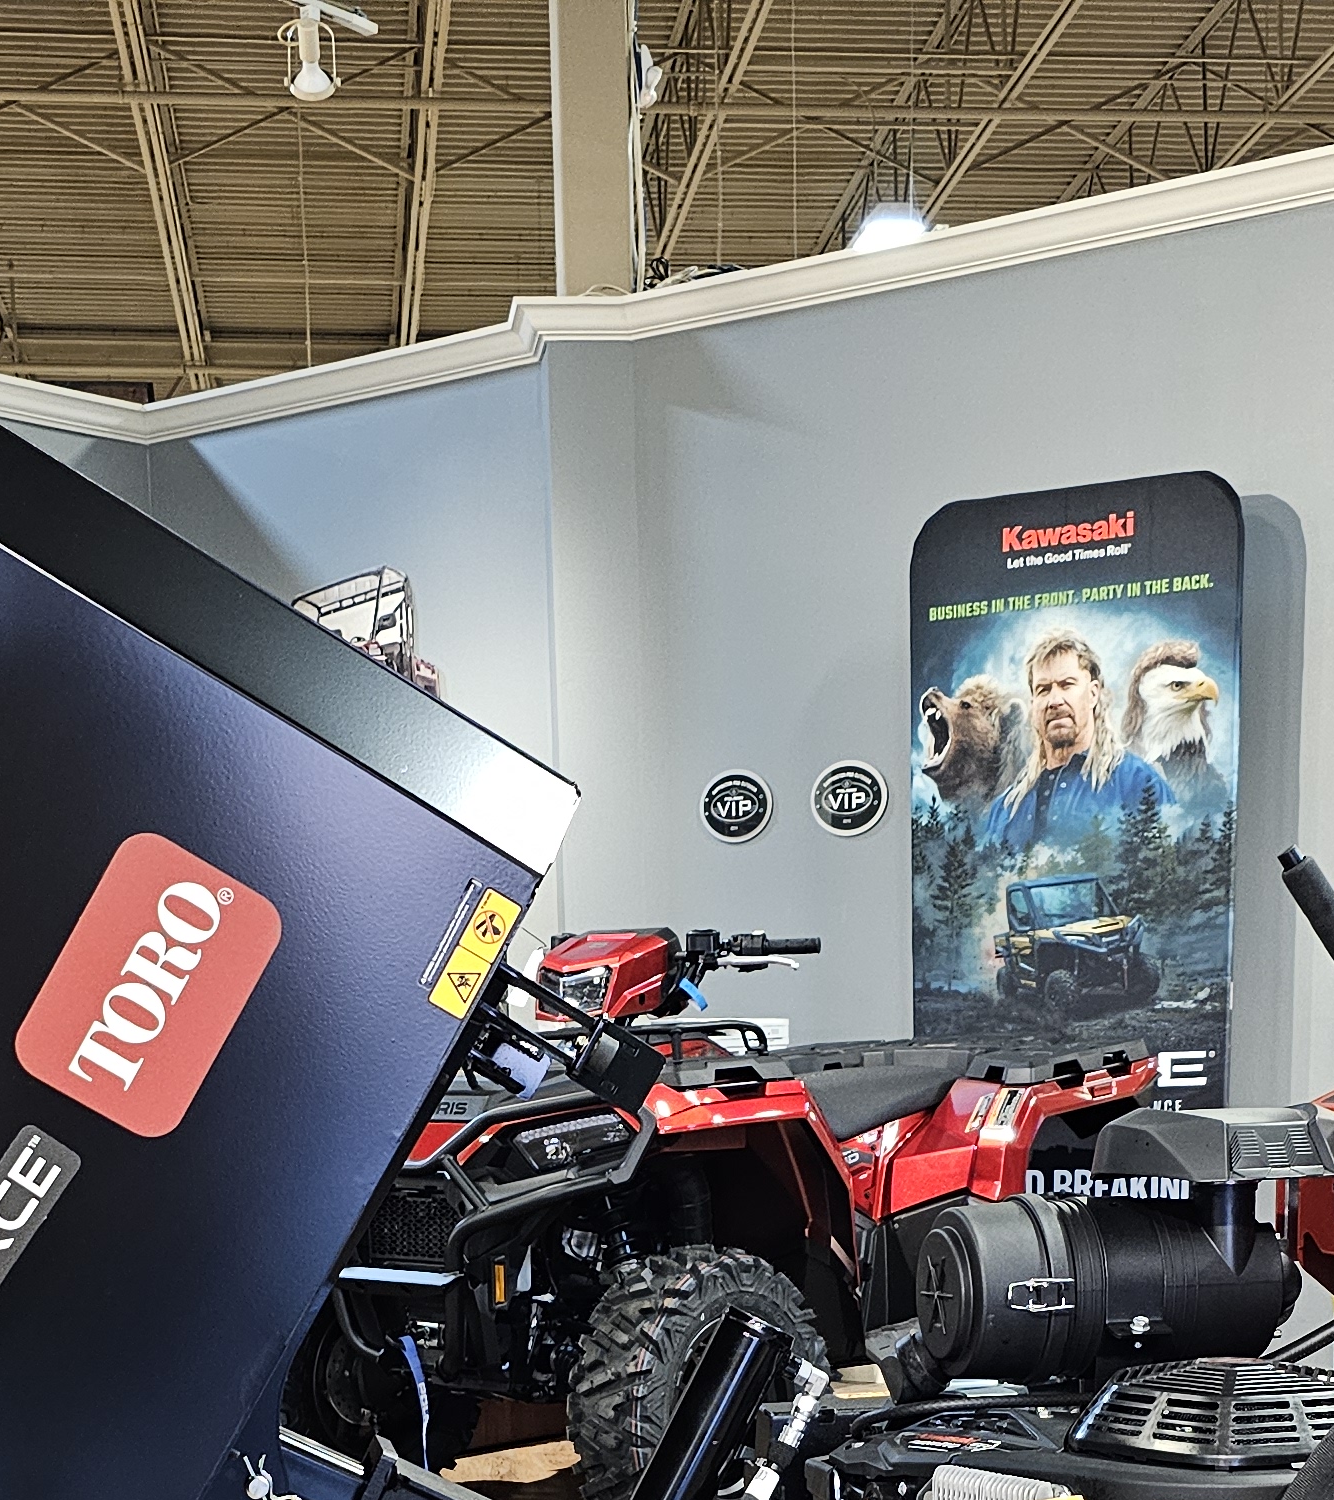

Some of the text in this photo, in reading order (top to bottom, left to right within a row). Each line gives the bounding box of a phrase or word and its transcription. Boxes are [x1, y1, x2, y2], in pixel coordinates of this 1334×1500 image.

[1002, 510, 1135, 553] Kawasaki
[1006, 543, 1129, 569] Let the Good Times Roll
[929, 600, 989, 621] BUSINESS
[991, 598, 1005, 614] IN
[1007, 594, 1032, 611] THE
[1082, 583, 1124, 603] PARTY
[1127, 581, 1141, 598] IN
[1144, 578, 1170, 596] THE
[1172, 573, 1214, 592] BACK.
[716, 799, 753, 818] VIP
[827, 791, 867, 811] VIP
[1053, 1168, 1190, 1200] BREAKIN
